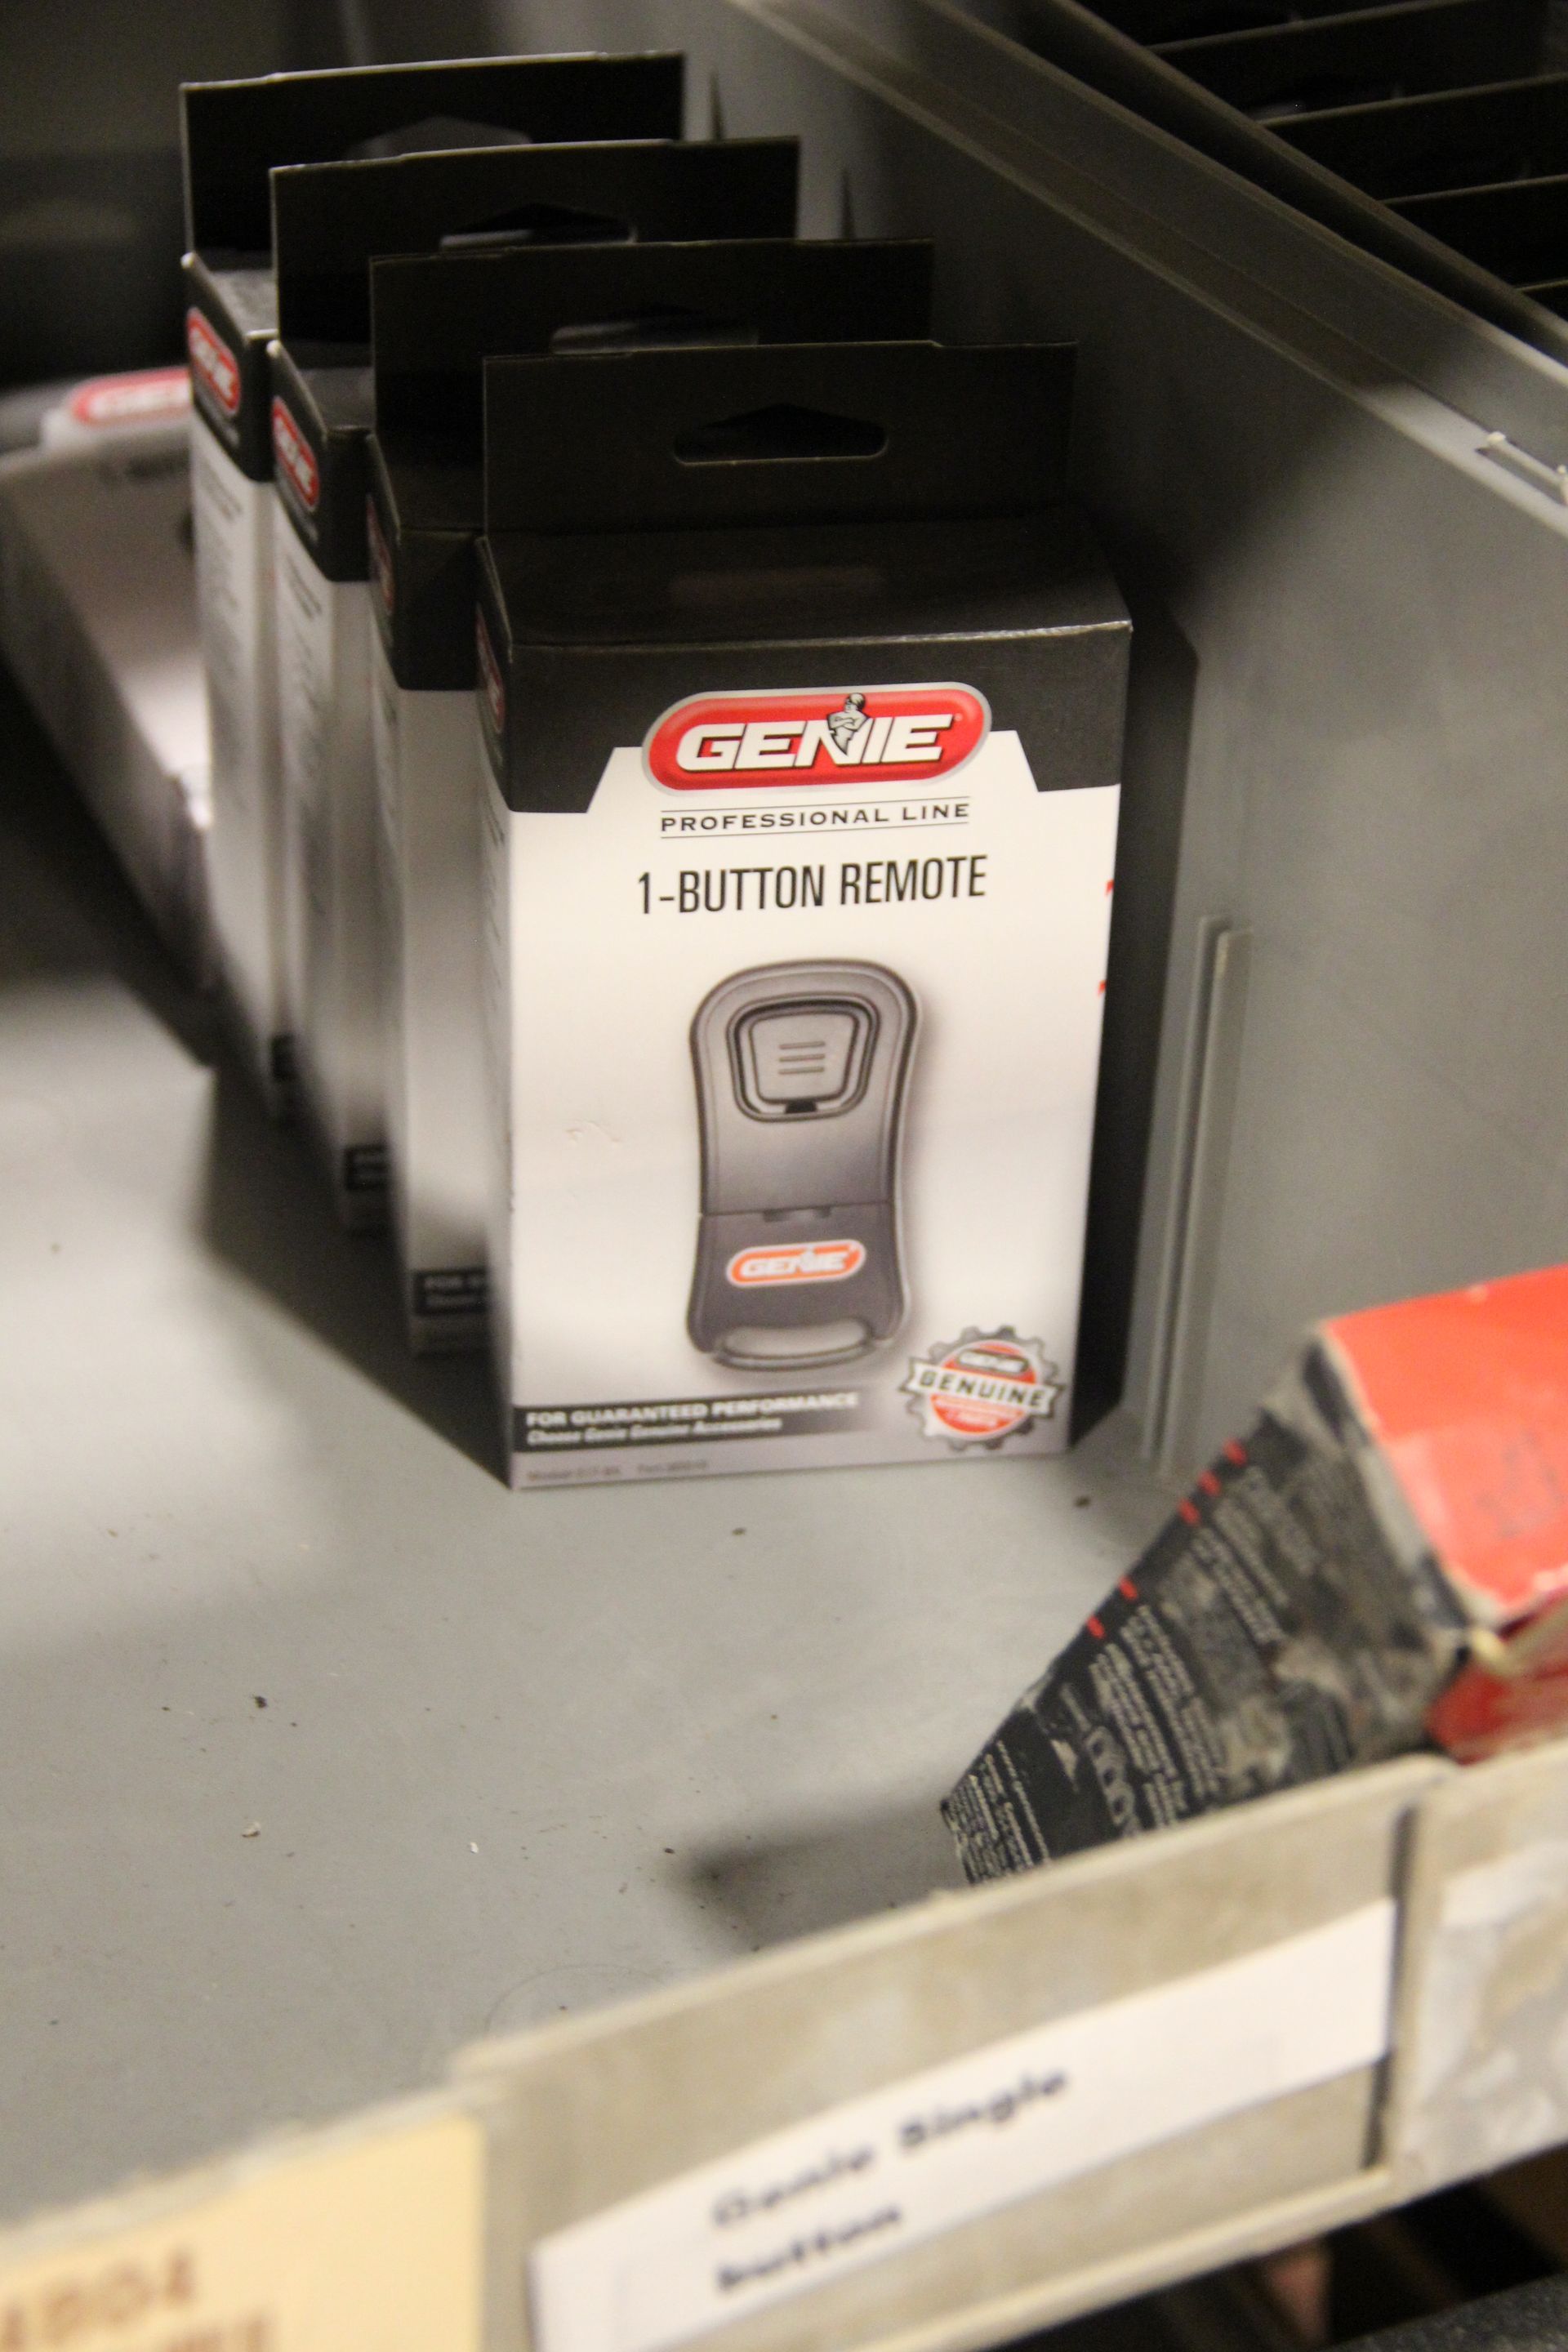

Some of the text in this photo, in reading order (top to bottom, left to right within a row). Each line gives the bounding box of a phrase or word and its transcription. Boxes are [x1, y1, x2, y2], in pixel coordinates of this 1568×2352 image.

[676, 713, 956, 773] GENIE
[660, 803, 970, 832] PROFESSIONAL LINE
[638, 854, 988, 915] 1-BUTTON REMOTE
[739, 1250, 851, 1278] GENIE
[526, 1392, 860, 1428] FOR GUARANTEED PERFORMANCE
[918, 1370, 1046, 1408] GENUINE
[712, 2070, 1068, 2225] Genie Single
[716, 2206, 902, 2296] button
